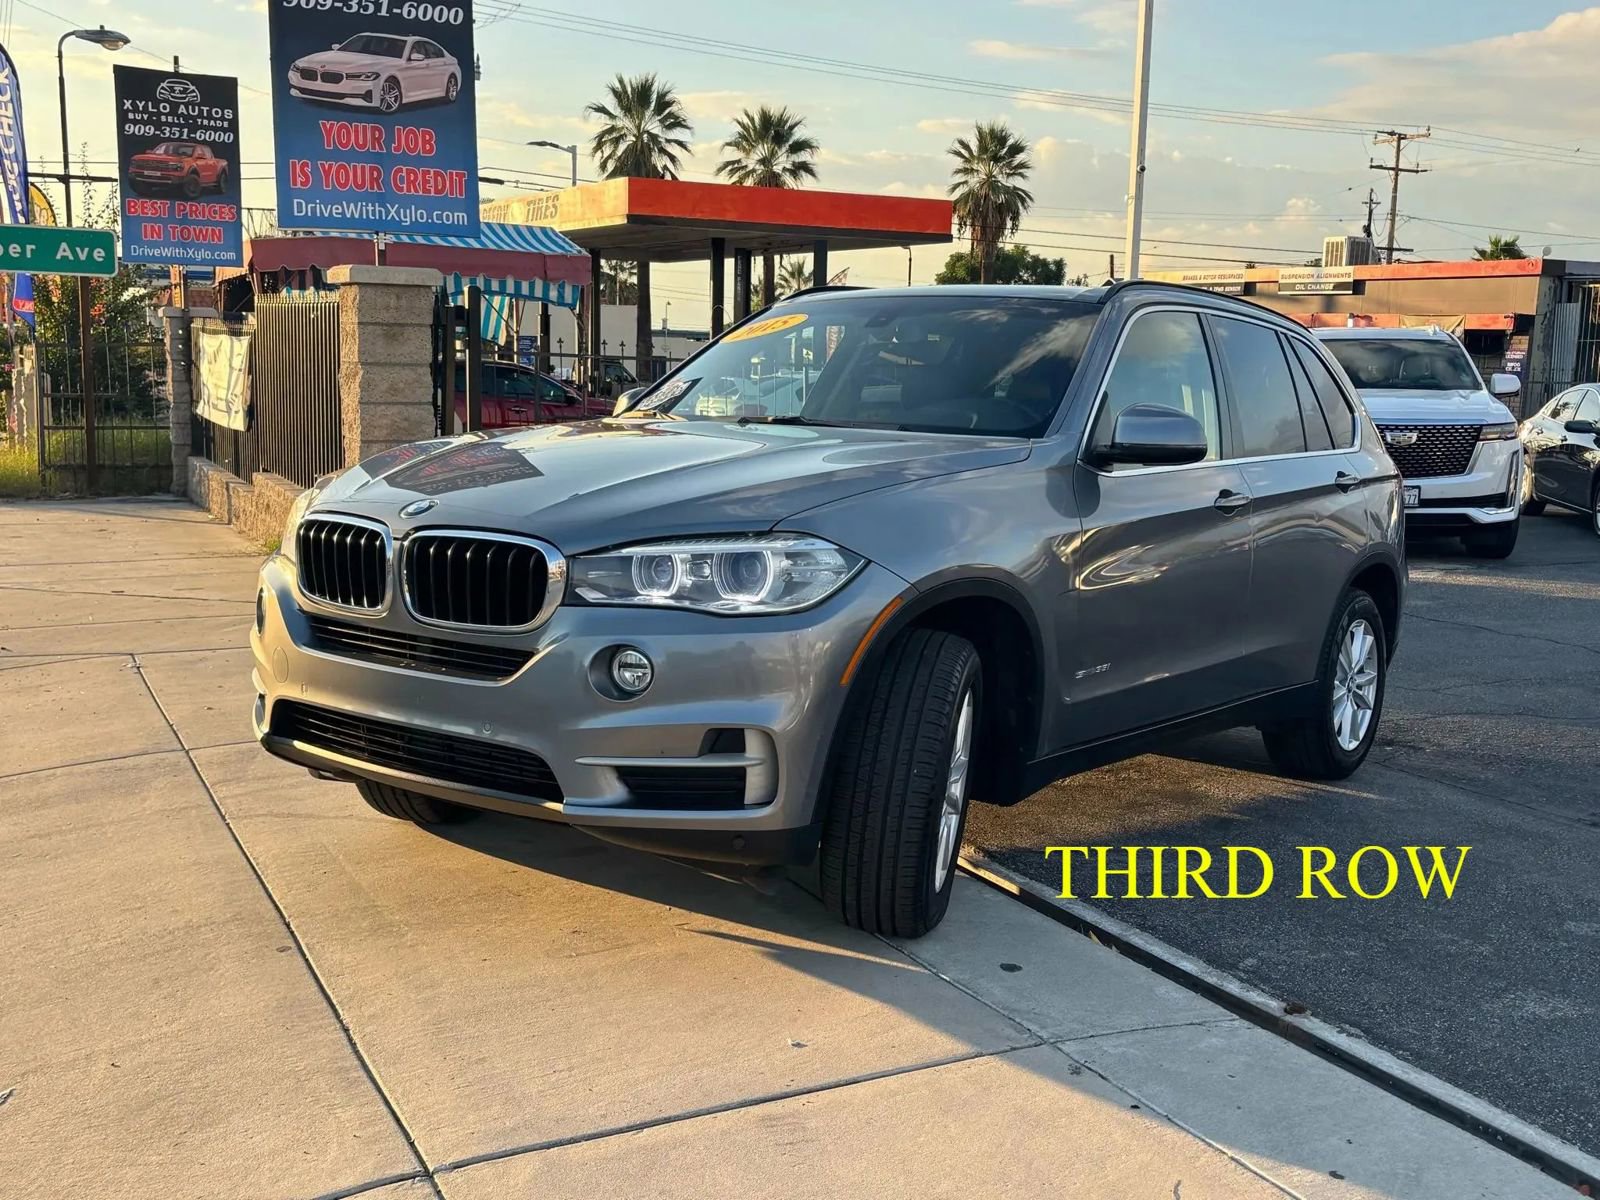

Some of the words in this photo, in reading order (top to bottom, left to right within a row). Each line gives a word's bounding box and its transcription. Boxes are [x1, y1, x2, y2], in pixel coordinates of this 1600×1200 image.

[123, 99, 170, 113] XYLO
[178, 104, 233, 119] AUTOS
[128, 112, 148, 120] BUY
[161, 115, 185, 124] SELL
[197, 118, 229, 127] TRADE
[124, 123, 234, 143] 909-351-6000
[319, 120, 386, 153] YOUR
[392, 126, 436, 156] JOB
[289, 160, 312, 190] IS
[319, 161, 385, 192] YOUR
[391, 166, 467, 198] CREDIT
[126, 198, 170, 218] BEST
[175, 201, 237, 222] PRICES
[293, 199, 468, 226] DriveWithXylo.com
[525, 194, 560, 222] TIRES
[142, 223, 164, 241] IN
[168, 224, 224, 244] TOWN
[55, 241, 106, 261] Ave
[130, 245, 236, 260] DriveWithXylo.com
[1280, 272, 1315, 280] SUSPENSION
[1316, 271, 1352, 279] ALIGNMENTS
